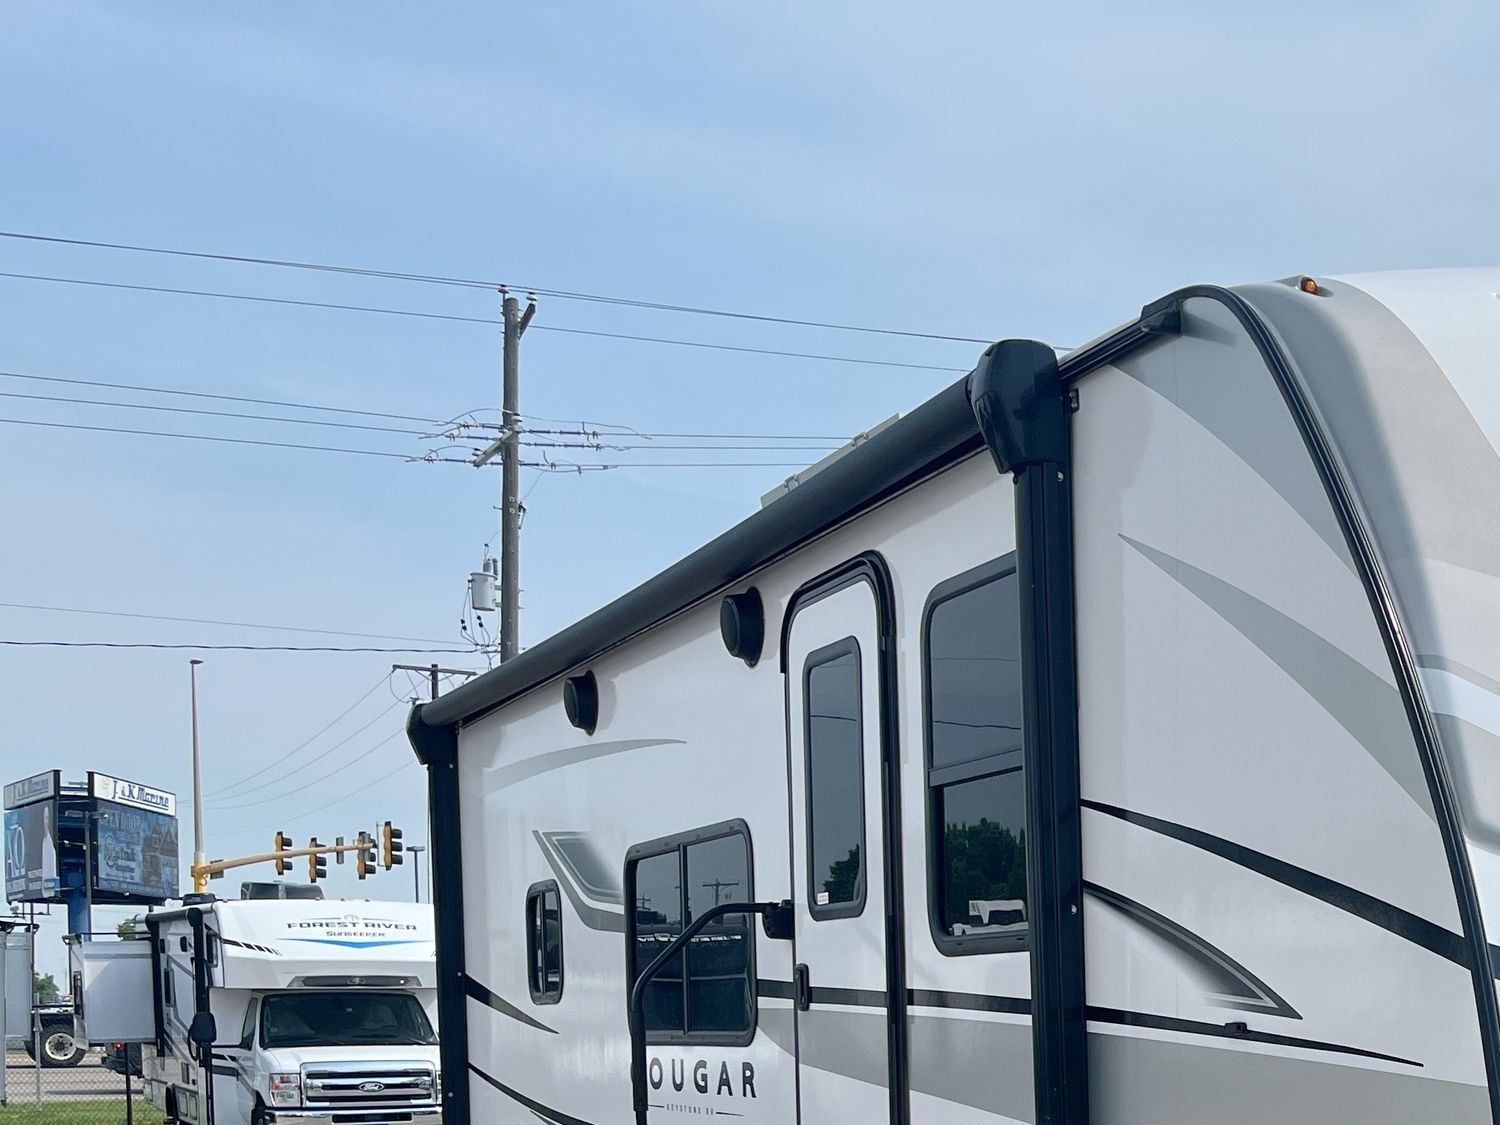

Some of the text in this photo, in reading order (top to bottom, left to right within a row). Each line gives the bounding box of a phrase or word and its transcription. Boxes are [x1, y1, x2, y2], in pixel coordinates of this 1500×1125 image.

[286, 921, 417, 931] FOREST RIVER
[649, 1056, 757, 1099] OUGAR
